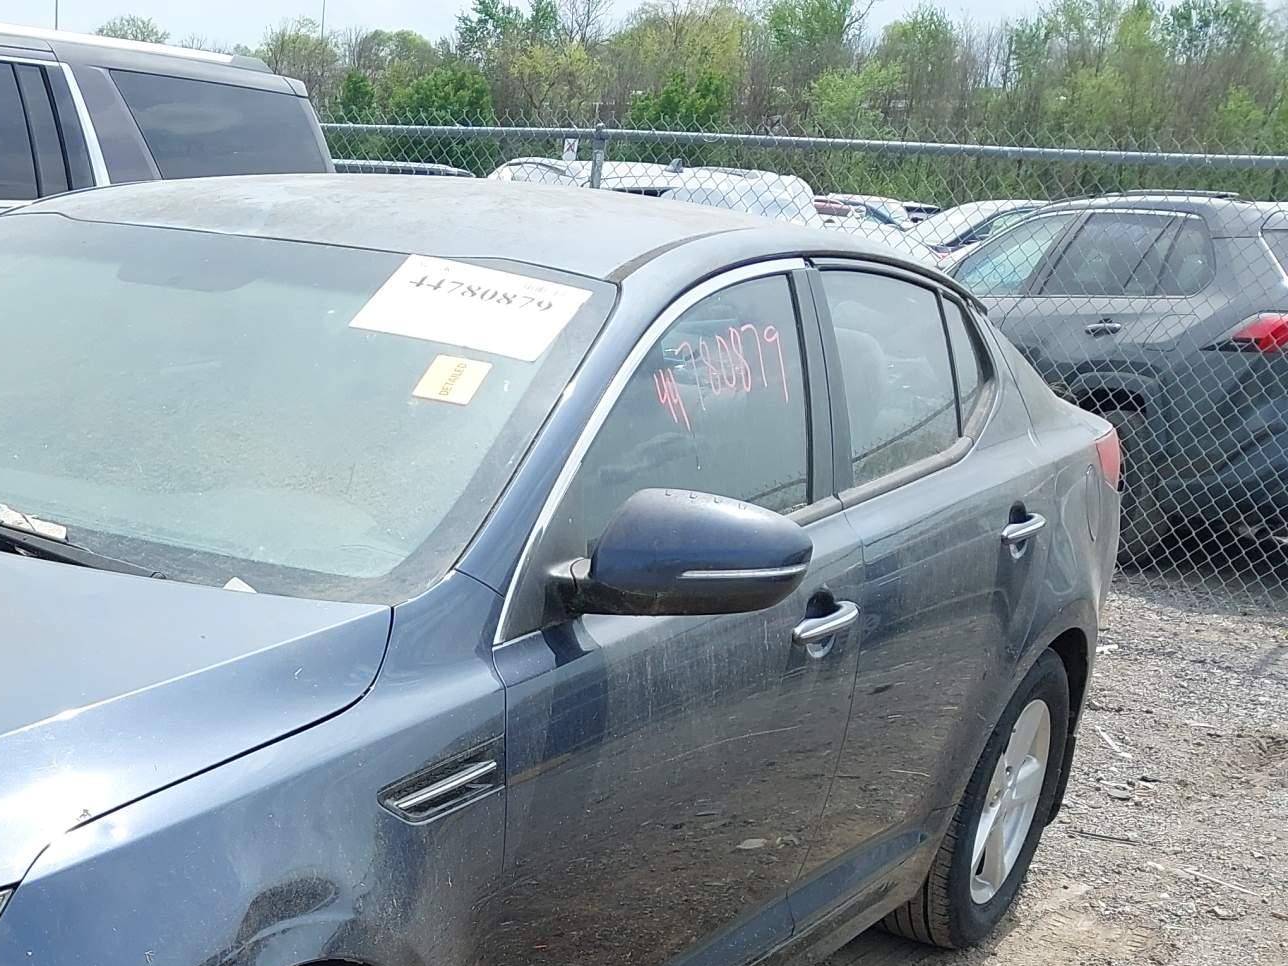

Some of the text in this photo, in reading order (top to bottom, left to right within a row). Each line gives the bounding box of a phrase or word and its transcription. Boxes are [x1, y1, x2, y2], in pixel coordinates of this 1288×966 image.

[409, 275, 553, 313] 44780879
[438, 362, 468, 397] DETAILED
[653, 324, 789, 433] 44780879
